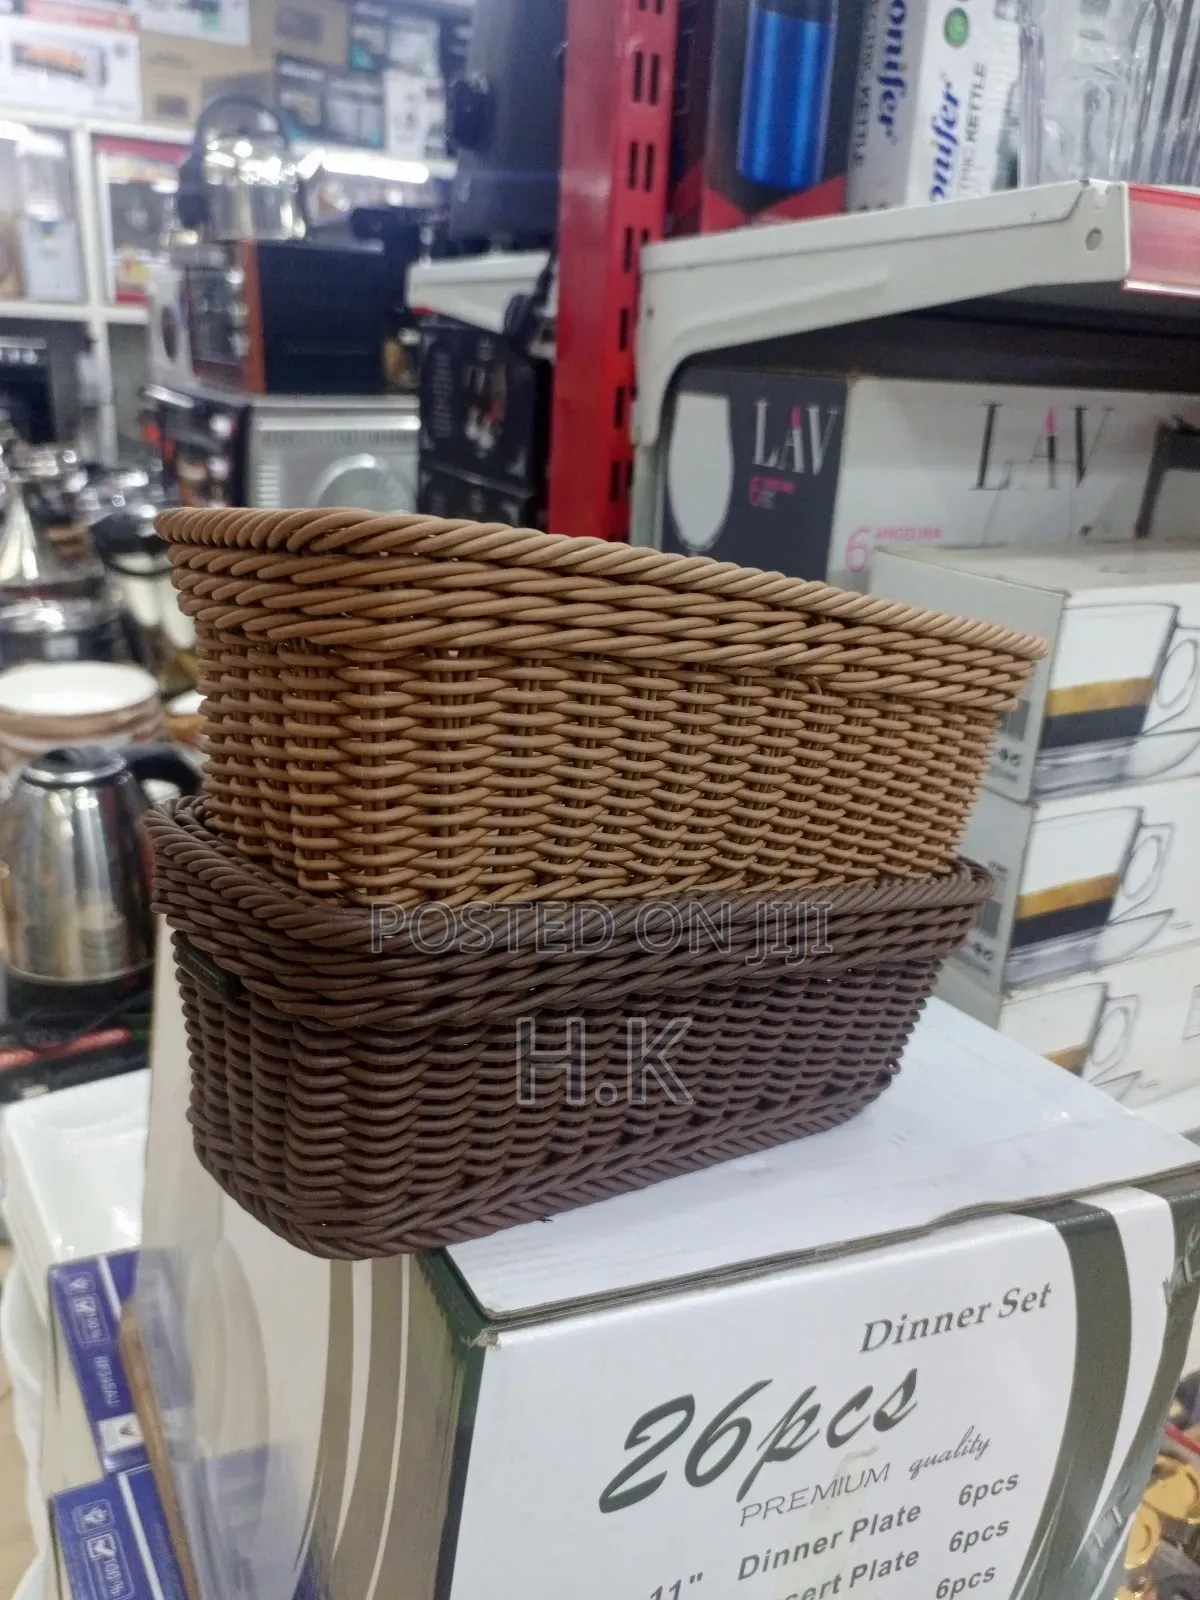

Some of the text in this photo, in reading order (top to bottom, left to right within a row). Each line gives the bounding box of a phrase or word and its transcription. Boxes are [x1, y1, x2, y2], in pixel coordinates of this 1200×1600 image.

[964, 62, 988, 143] KETTLE
[752, 399, 839, 476] LAV
[969, 402, 1114, 489] LAV
[844, 527, 869, 573] 6
[859, 1281, 1052, 1353] Dinner Set
[599, 1367, 918, 1513] 26pcs
[740, 1425, 991, 1527] PREMIUM quality
[737, 1530, 844, 1581] Dinner
[849, 1505, 921, 1543] Plate
[958, 1472, 1018, 1507] 6pcs
[849, 1550, 919, 1588] Plate
[948, 1519, 1010, 1553] 6pcs
[935, 1566, 996, 1600] 6pcs
